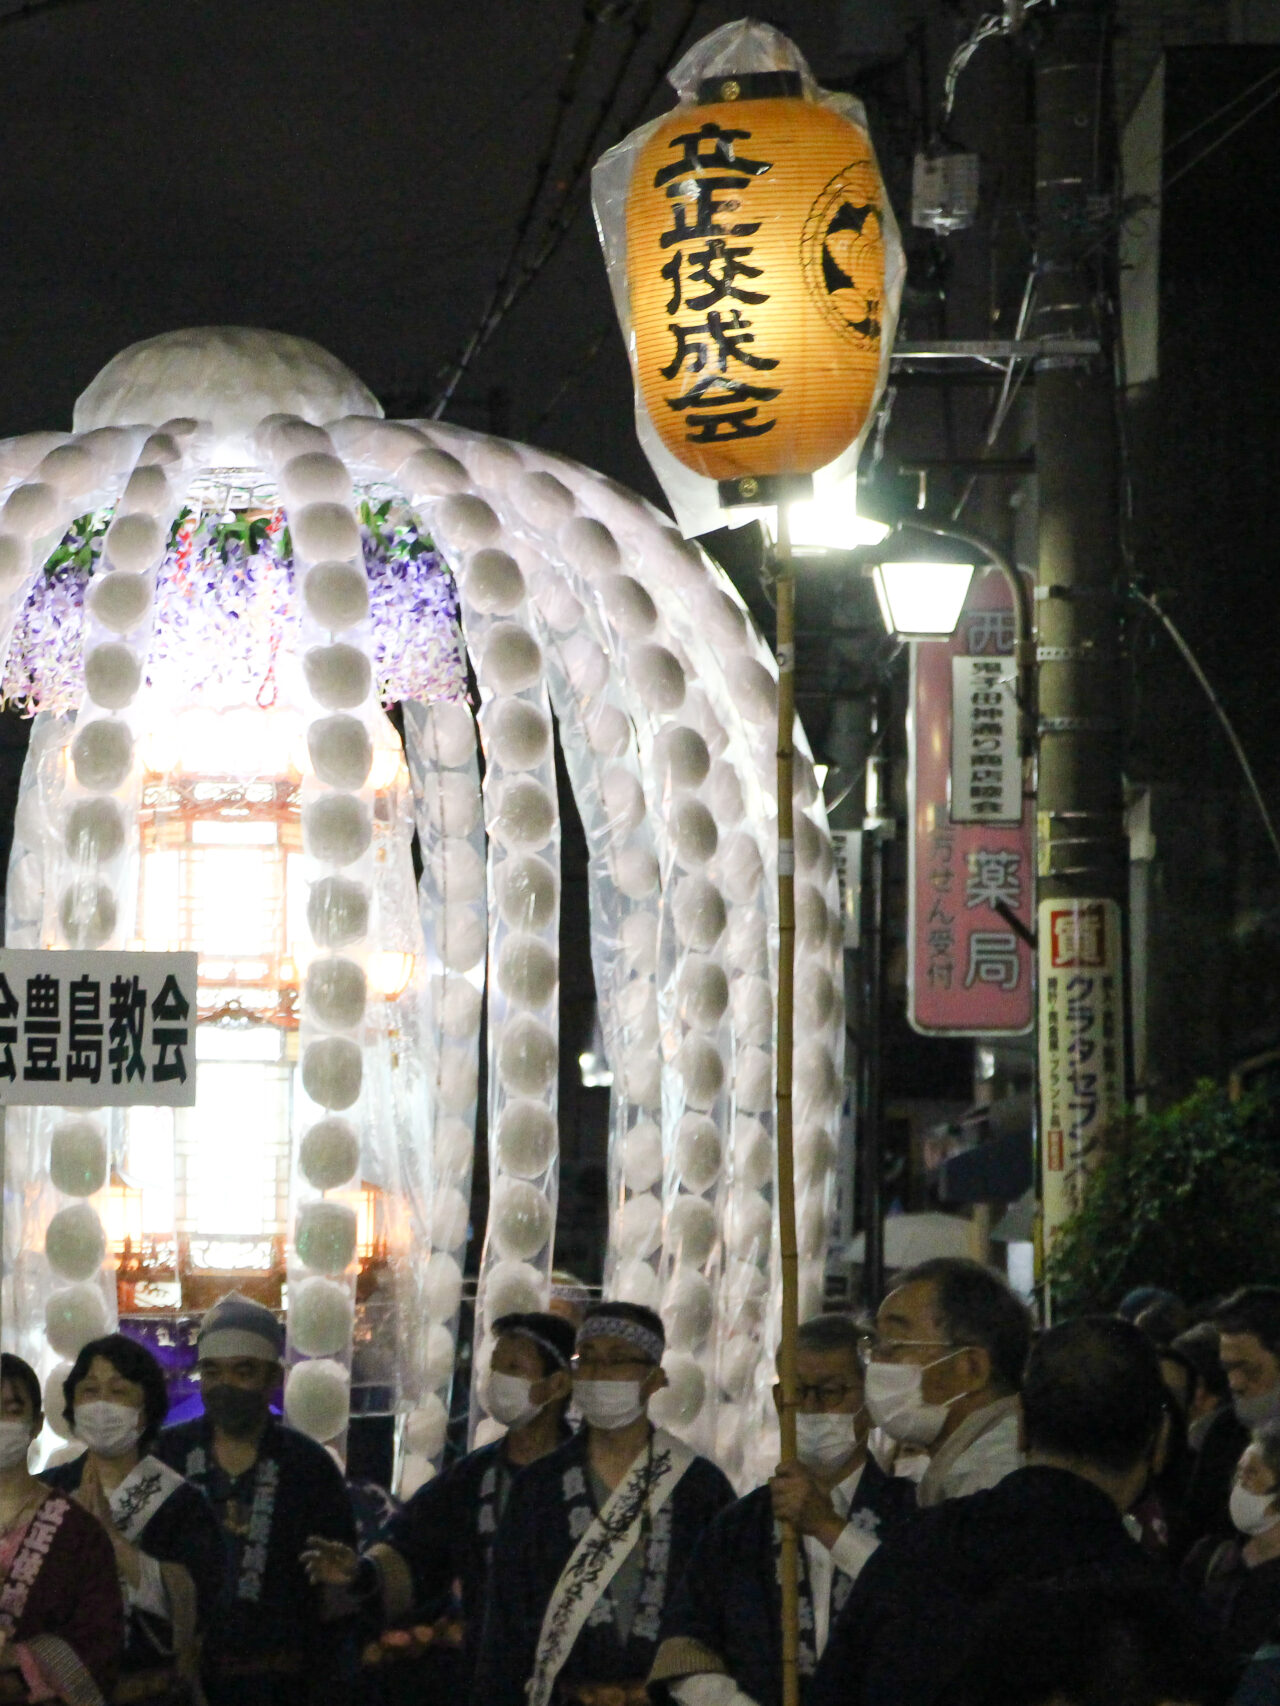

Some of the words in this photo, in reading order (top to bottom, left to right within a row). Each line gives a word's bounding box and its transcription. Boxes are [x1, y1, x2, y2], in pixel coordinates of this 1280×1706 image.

[655, 123, 783, 443] 立正佼成会
[964, 852, 1021, 988] 薬局
